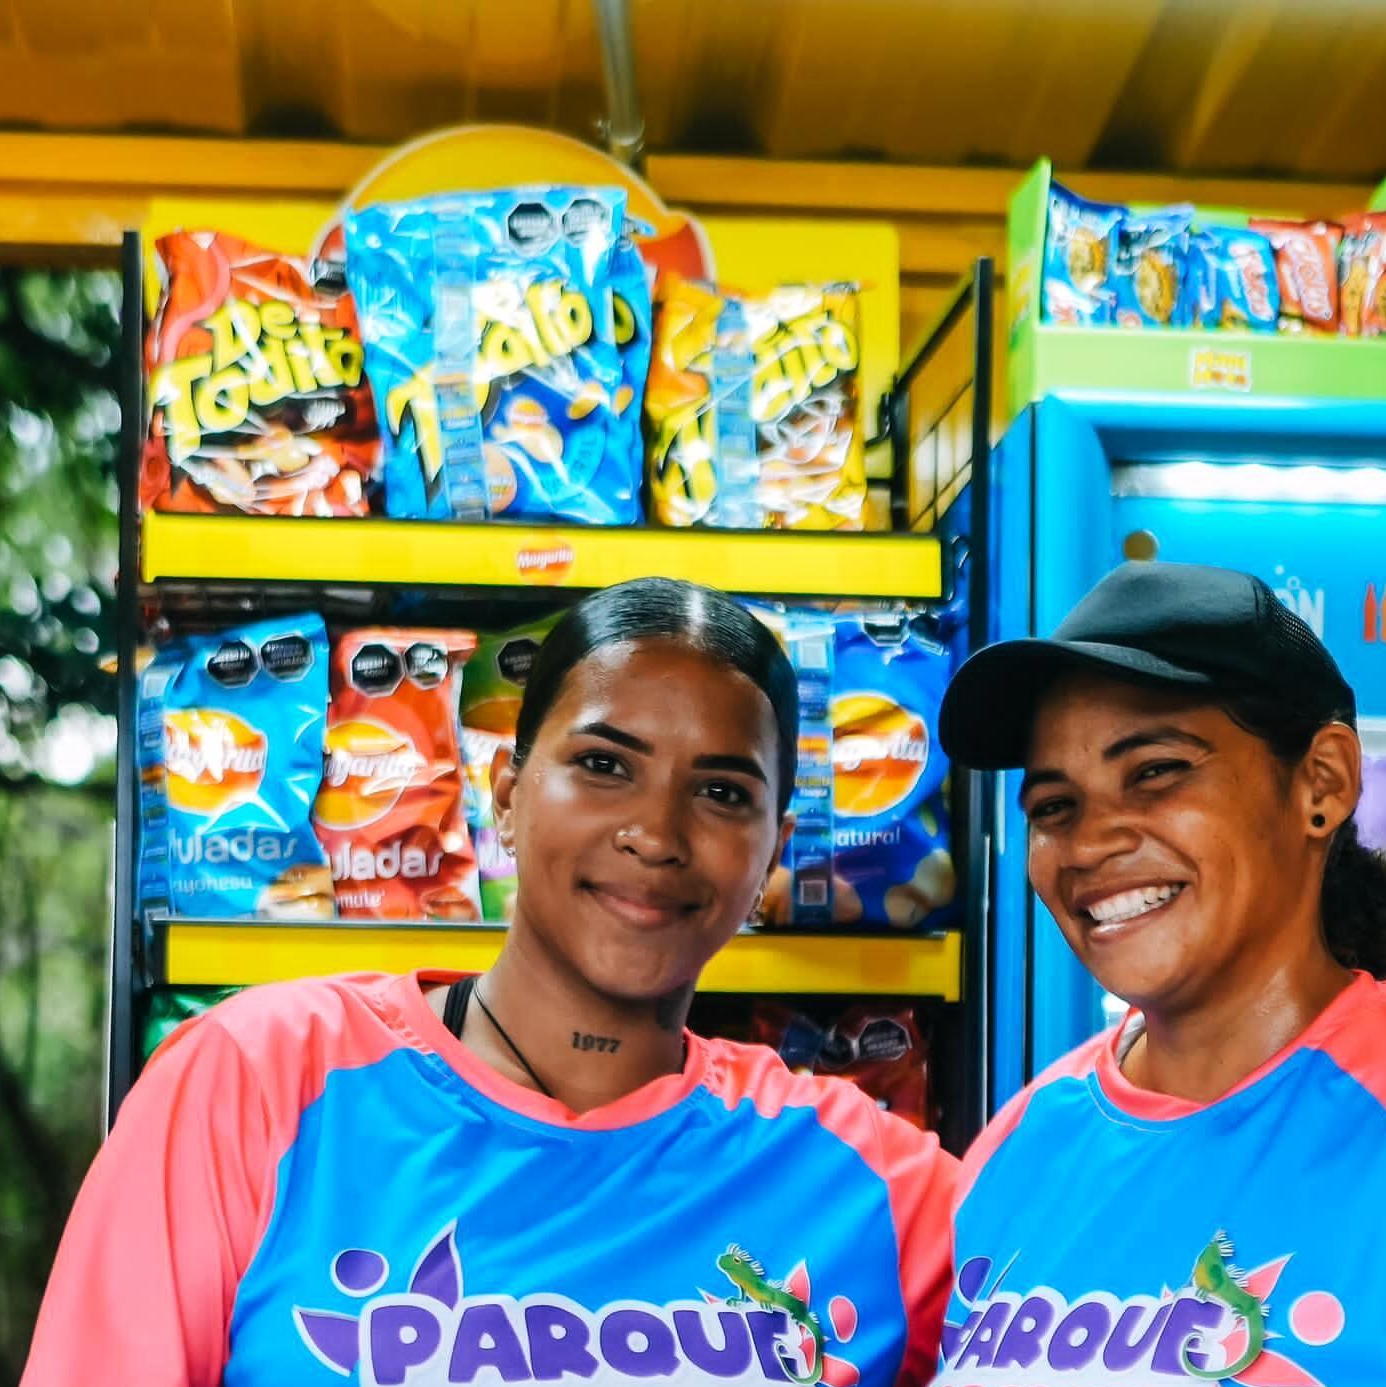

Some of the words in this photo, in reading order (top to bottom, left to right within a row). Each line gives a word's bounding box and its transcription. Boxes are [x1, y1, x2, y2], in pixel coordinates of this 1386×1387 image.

[205, 297, 298, 370] De
[168, 828, 300, 865] uladas
[572, 1031, 622, 1054] 1977
[369, 1303, 800, 1385] PARQUE
